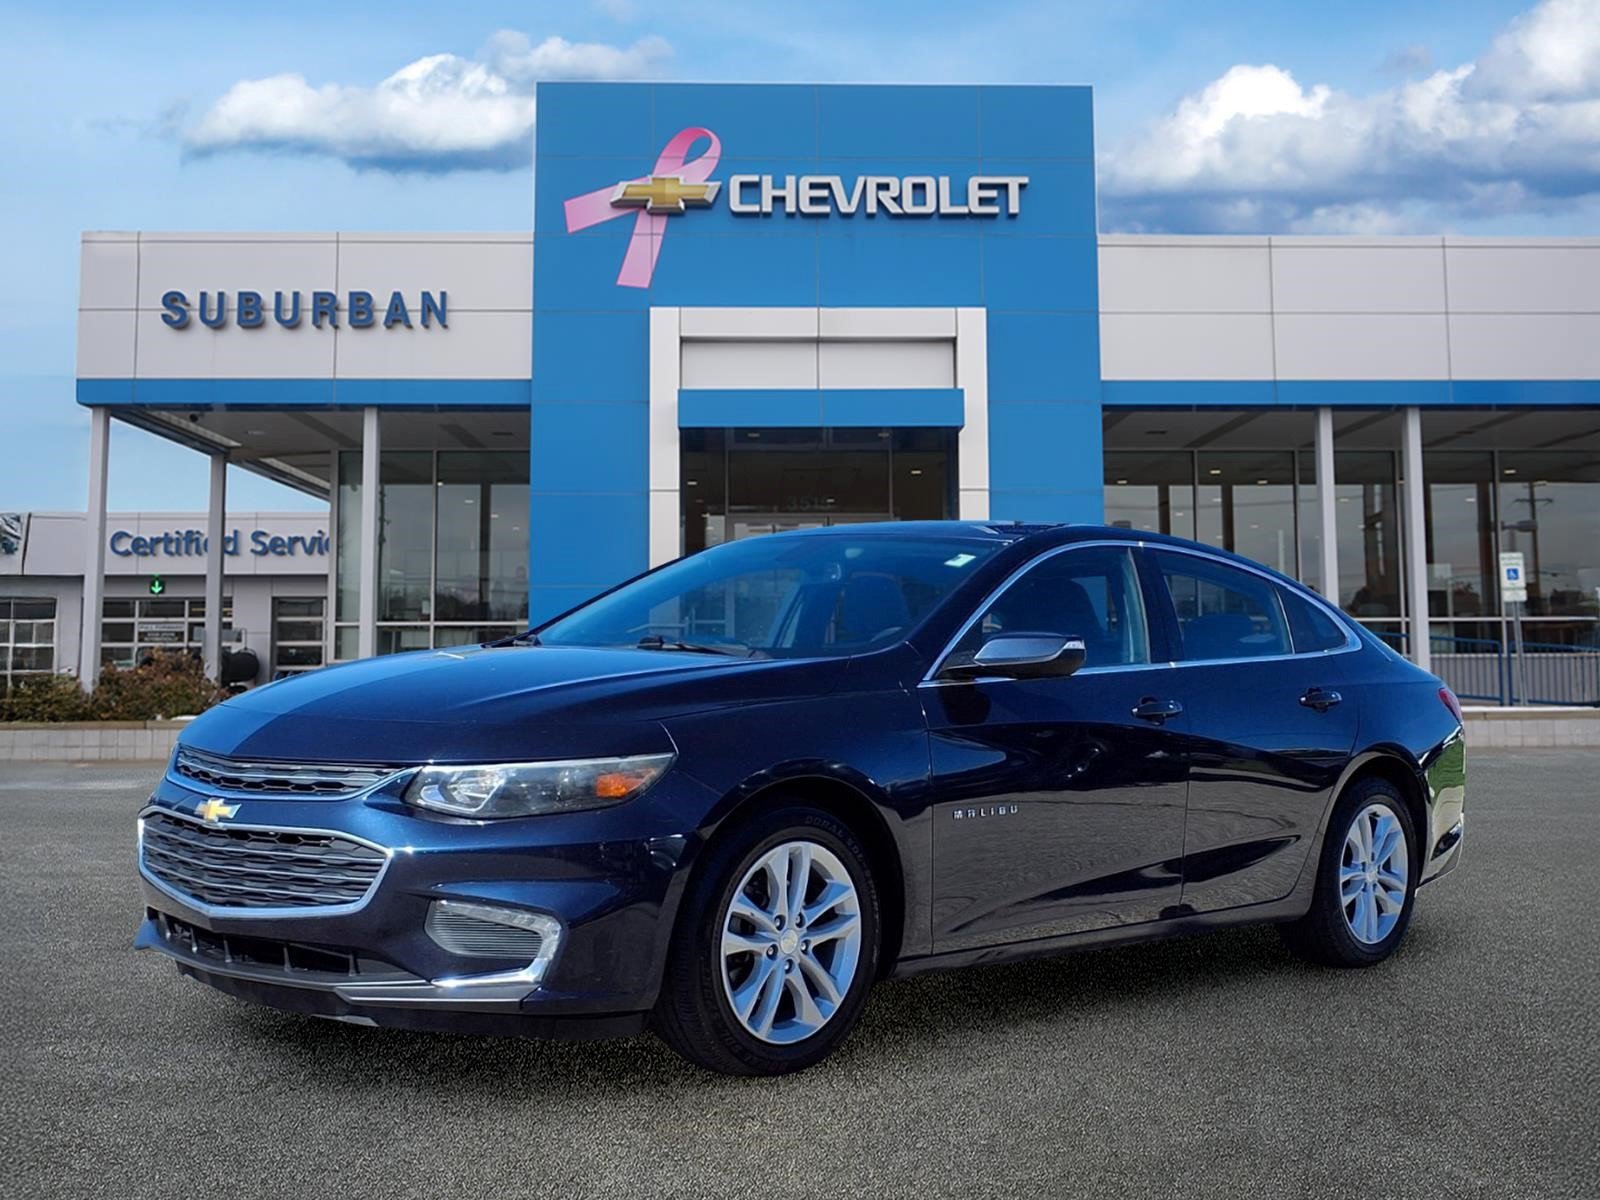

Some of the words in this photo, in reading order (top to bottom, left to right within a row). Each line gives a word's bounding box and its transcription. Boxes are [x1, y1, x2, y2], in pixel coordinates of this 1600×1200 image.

[729, 174, 1029, 216] CHEVROLET
[161, 290, 449, 329] SUBURBAN
[953, 804, 1019, 820] MALIBU
